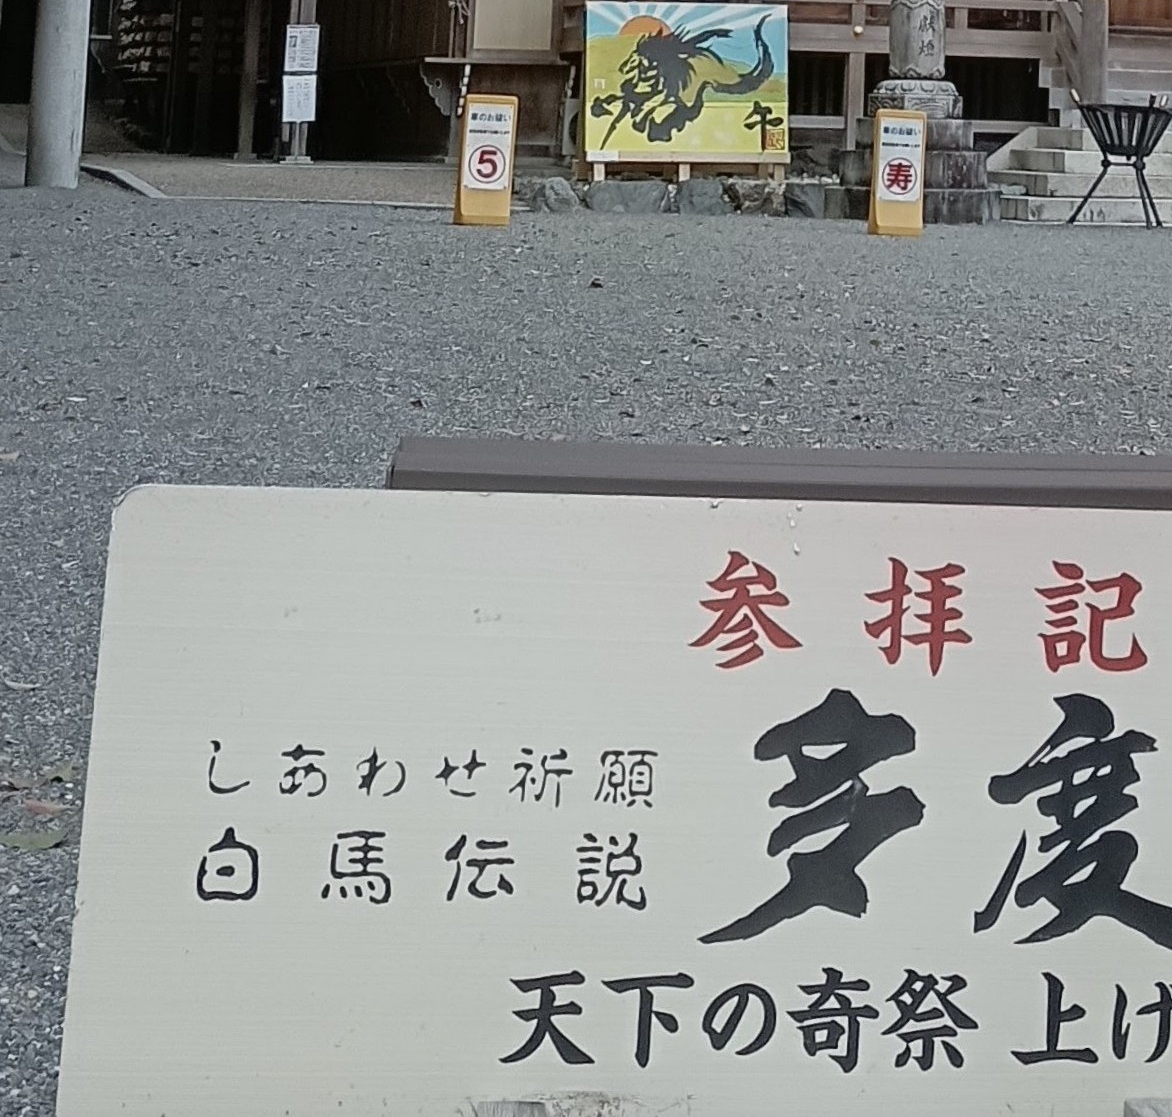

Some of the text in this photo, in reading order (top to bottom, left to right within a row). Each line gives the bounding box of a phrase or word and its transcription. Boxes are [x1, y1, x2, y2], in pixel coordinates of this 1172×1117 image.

[476, 149, 498, 179] 5
[886, 162, 913, 191] 寿
[207, 740, 658, 808] しあわせ祈願
[197, 827, 646, 910] 白馬伝説
[499, 967, 978, 1073] 天下の奇祭
